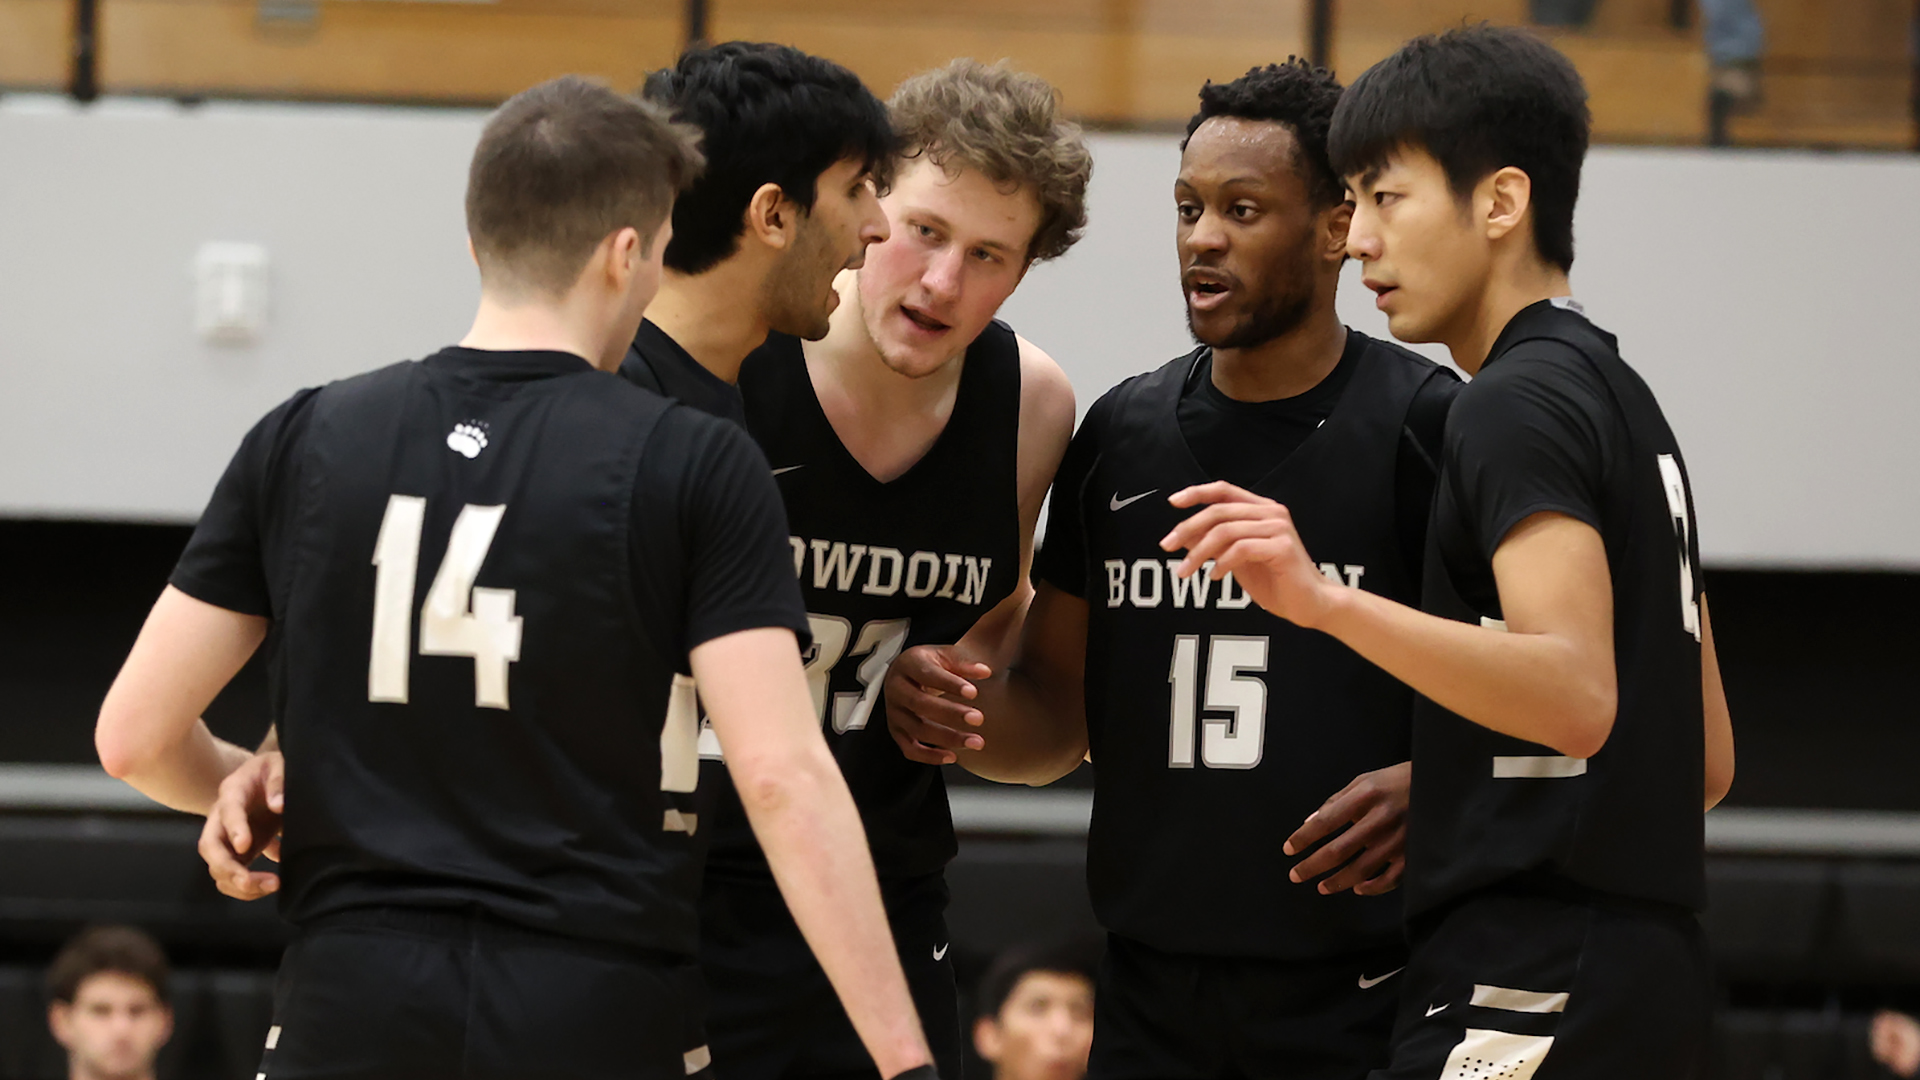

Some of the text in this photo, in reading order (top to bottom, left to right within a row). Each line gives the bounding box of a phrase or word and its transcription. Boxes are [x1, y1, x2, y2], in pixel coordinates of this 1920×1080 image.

[368, 494, 524, 710] 14
[789, 534, 992, 605] WDOIN
[1168, 634, 1270, 769] 15
